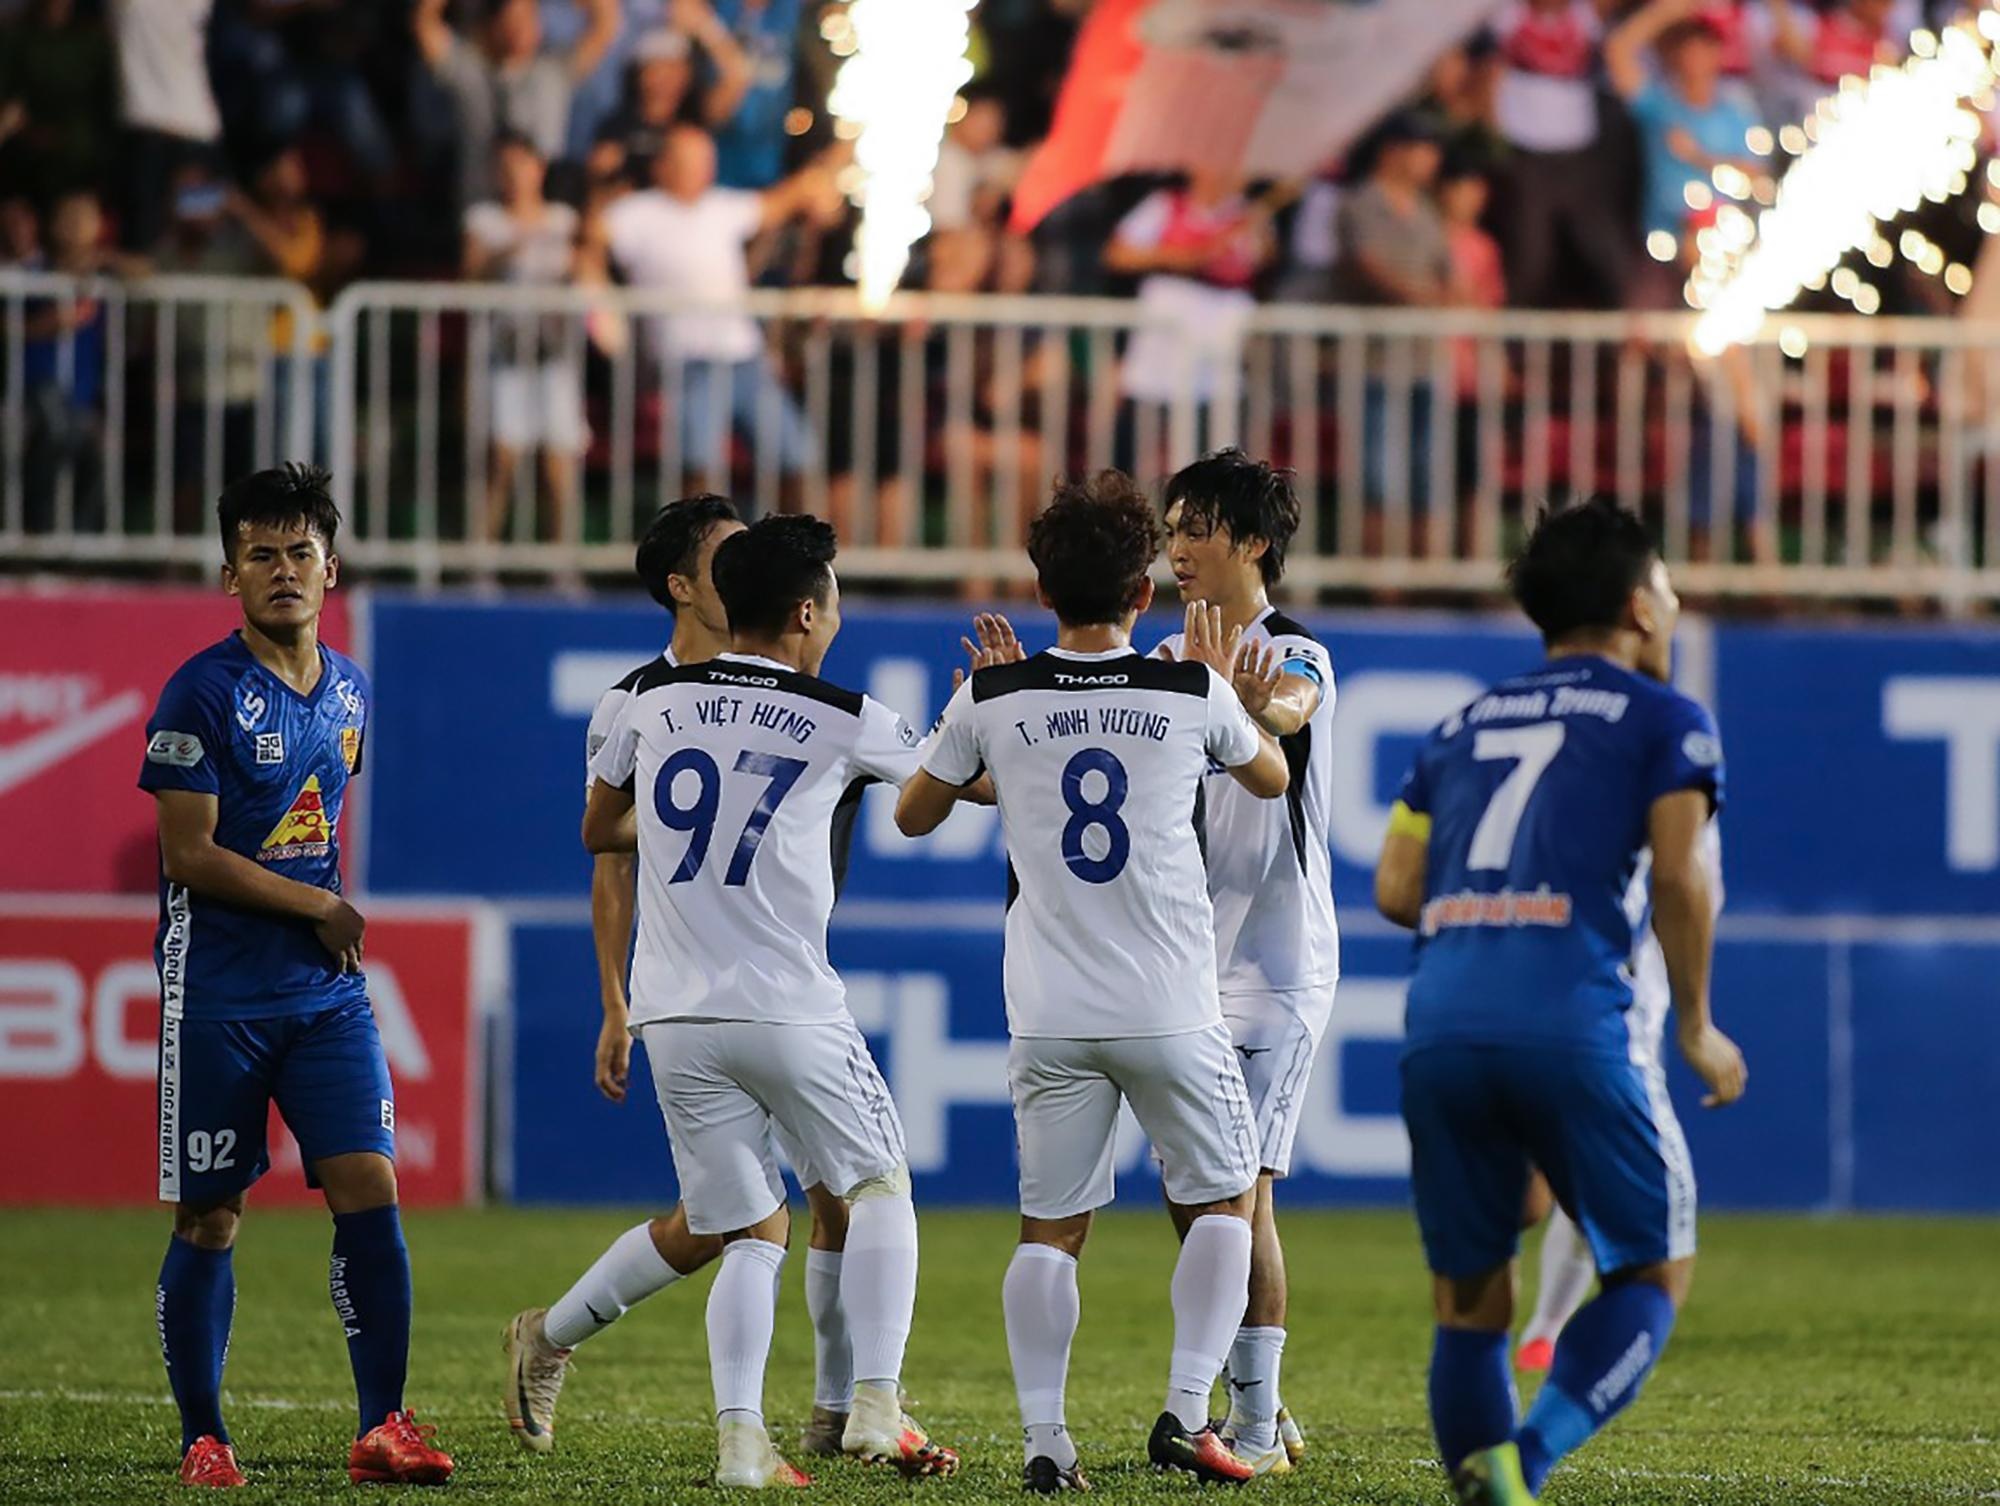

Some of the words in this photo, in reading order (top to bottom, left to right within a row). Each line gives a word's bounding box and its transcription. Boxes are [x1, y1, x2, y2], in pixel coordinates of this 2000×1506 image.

[708, 671, 778, 688] THACO
[1054, 674, 1129, 685] THACO
[236, 692, 266, 732] LS
[660, 709, 683, 734] T.
[696, 696, 743, 727] VIỆT
[750, 702, 817, 744] HƯNG
[1015, 721, 1039, 746] T.
[1046, 708, 1090, 740] MINH
[1099, 707, 1171, 742] VƯƠNG
[654, 748, 808, 887] 97
[1061, 747, 1131, 884] 8
[1466, 720, 1566, 871] 7
[187, 1128, 237, 1172] 92
